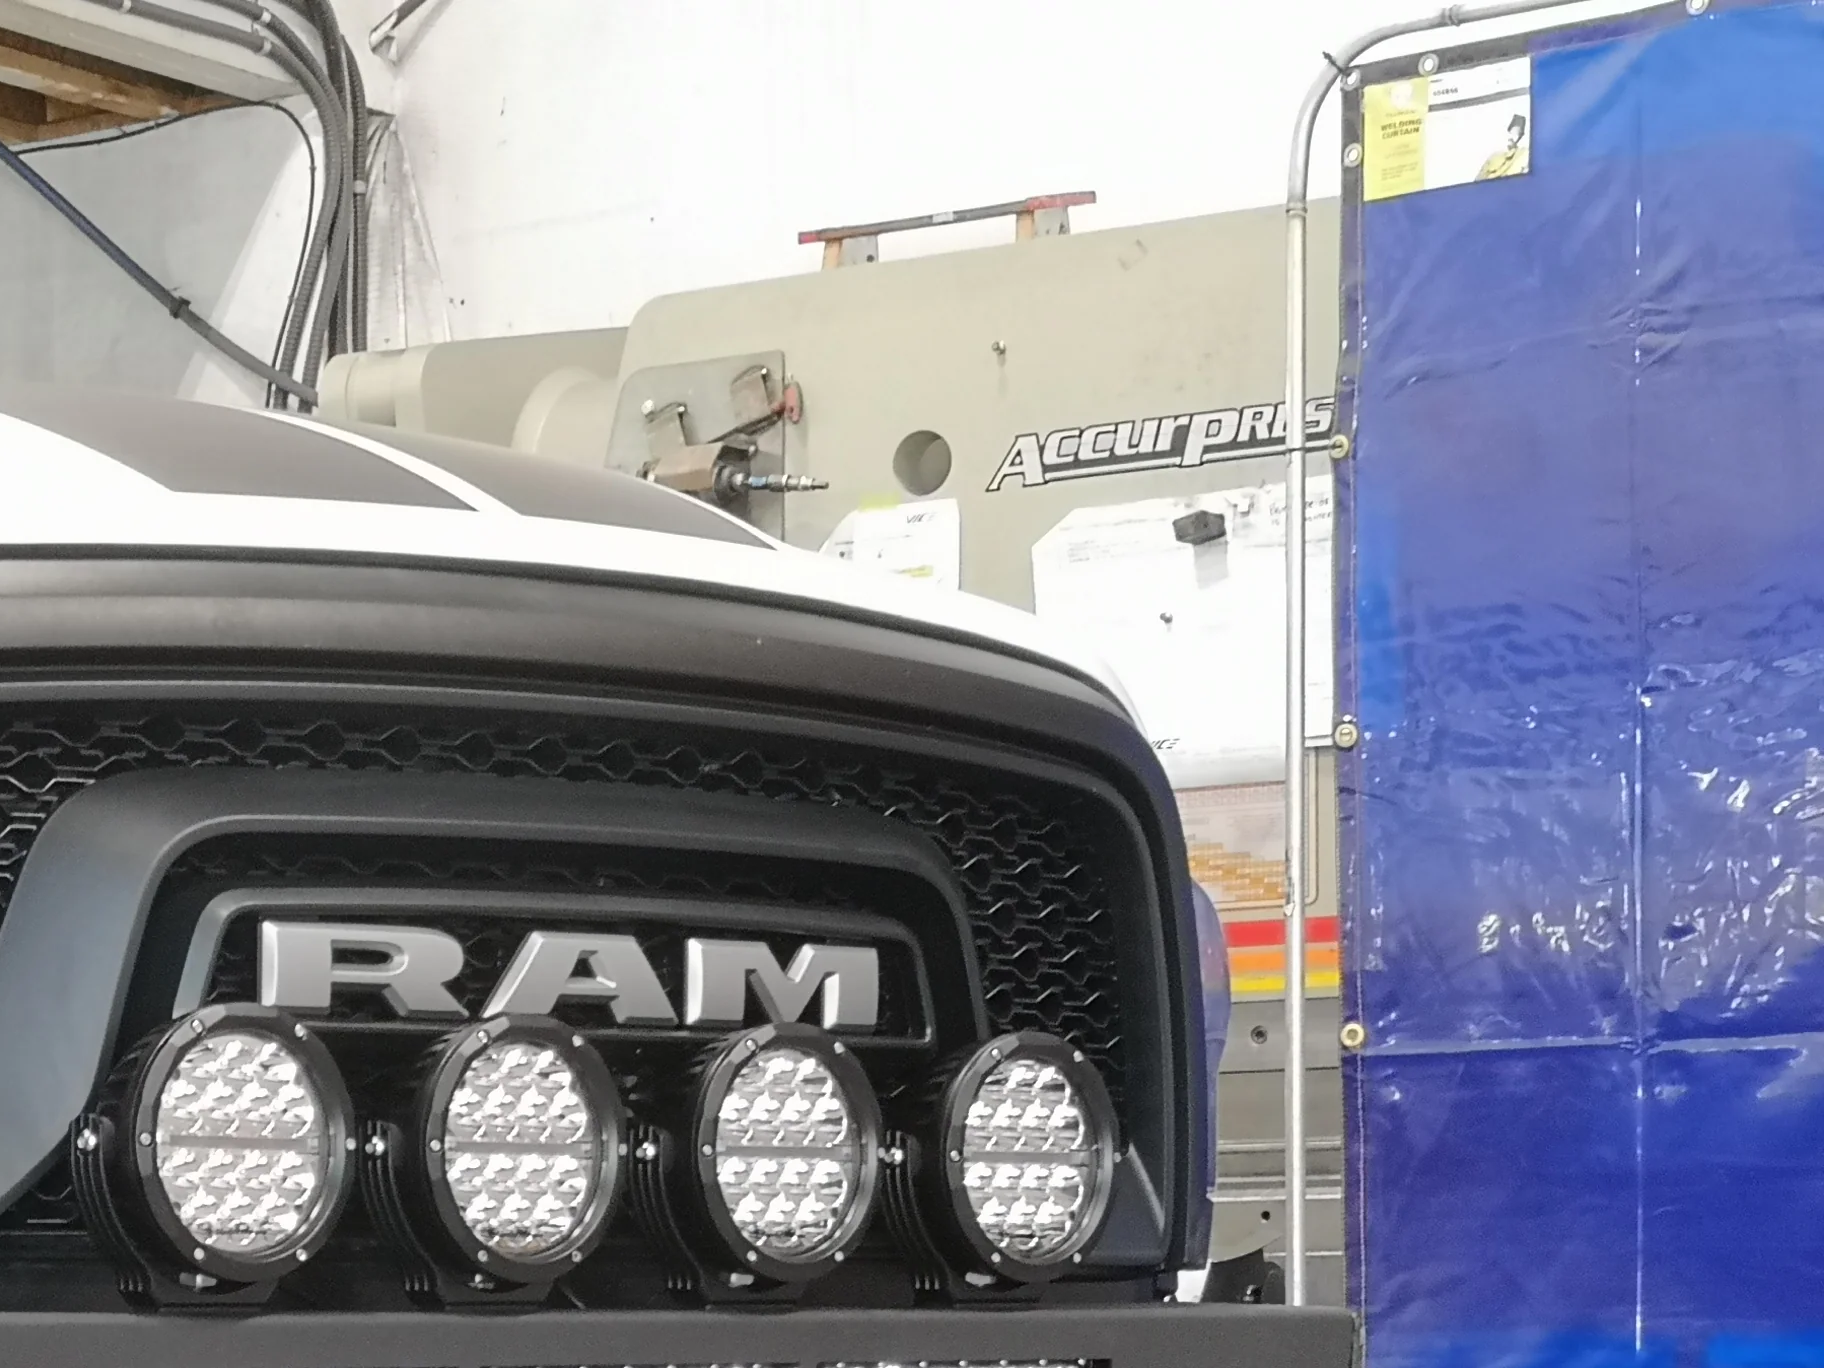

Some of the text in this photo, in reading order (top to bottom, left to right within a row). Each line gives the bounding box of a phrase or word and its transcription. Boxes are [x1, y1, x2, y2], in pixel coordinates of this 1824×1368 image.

[1380, 118, 1423, 132] WELDING
[1382, 126, 1420, 140] CURTAIN
[260, 920, 879, 1029] RAM
